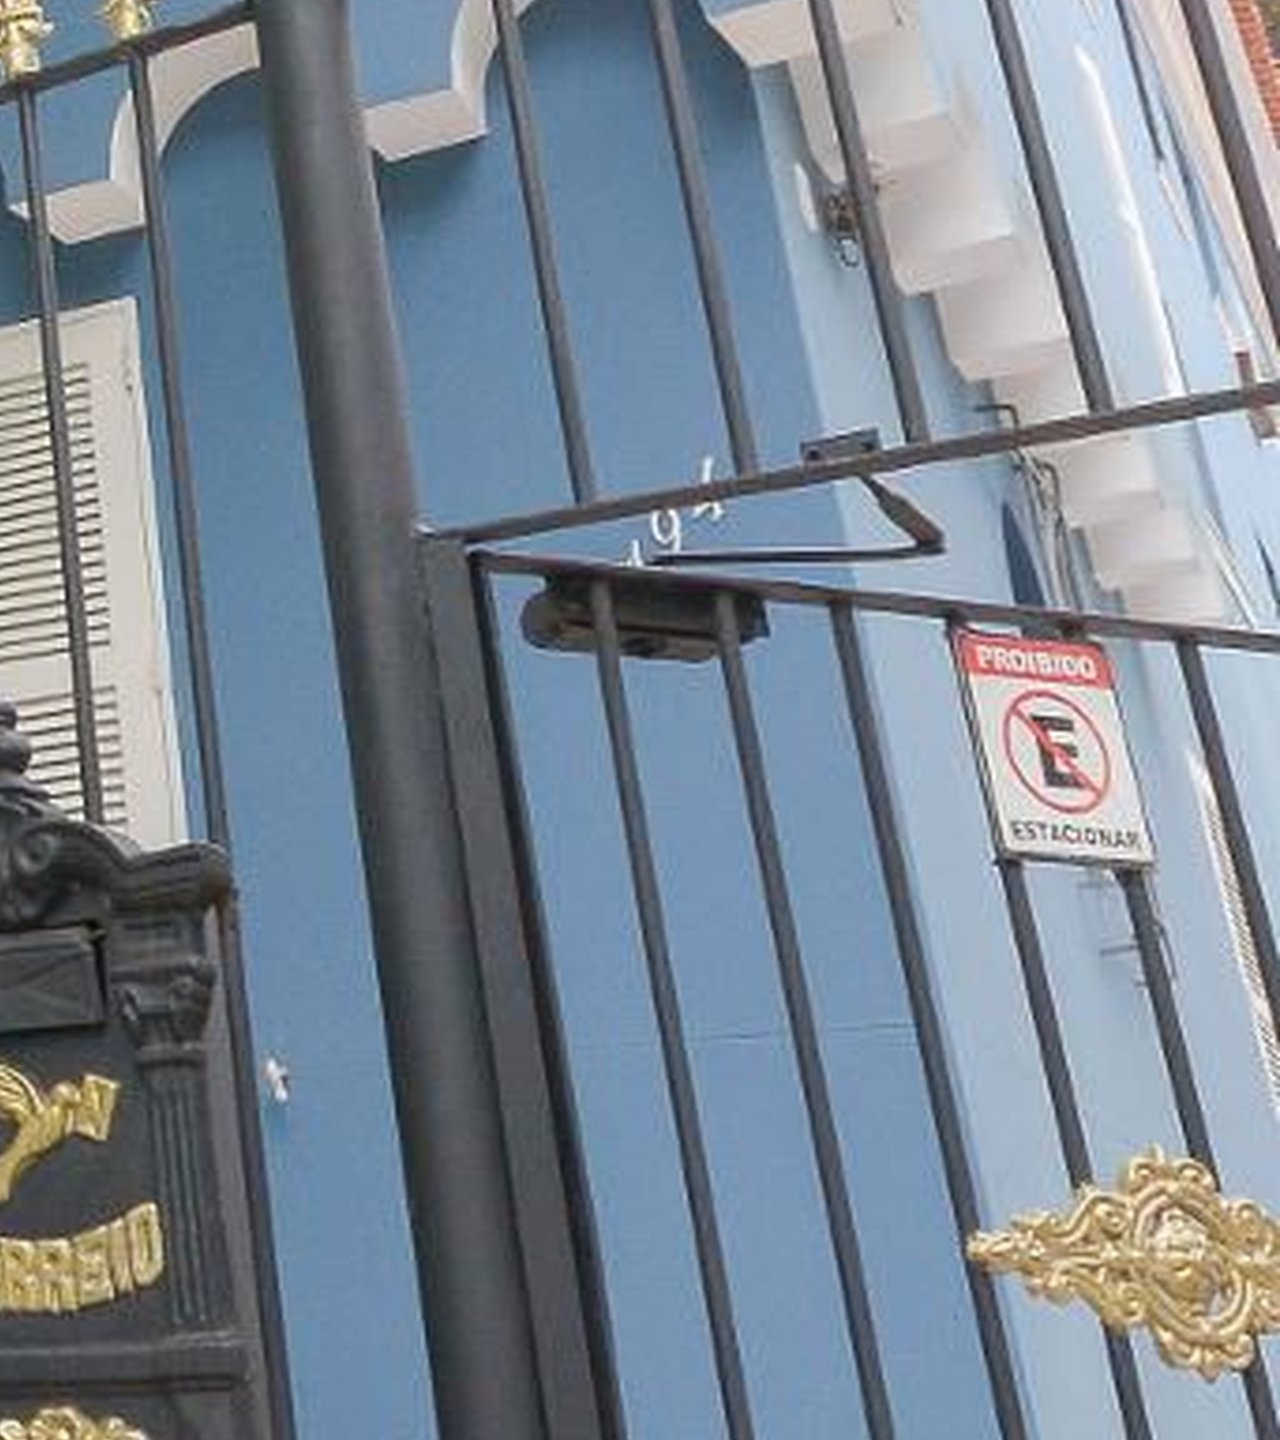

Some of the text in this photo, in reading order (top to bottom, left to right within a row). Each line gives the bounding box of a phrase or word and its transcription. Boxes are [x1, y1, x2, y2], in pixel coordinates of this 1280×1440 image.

[974, 644, 1098, 680] PROIBIDO
[1031, 714, 1085, 789] E
[1011, 821, 1142, 850] ESTACIONAR
